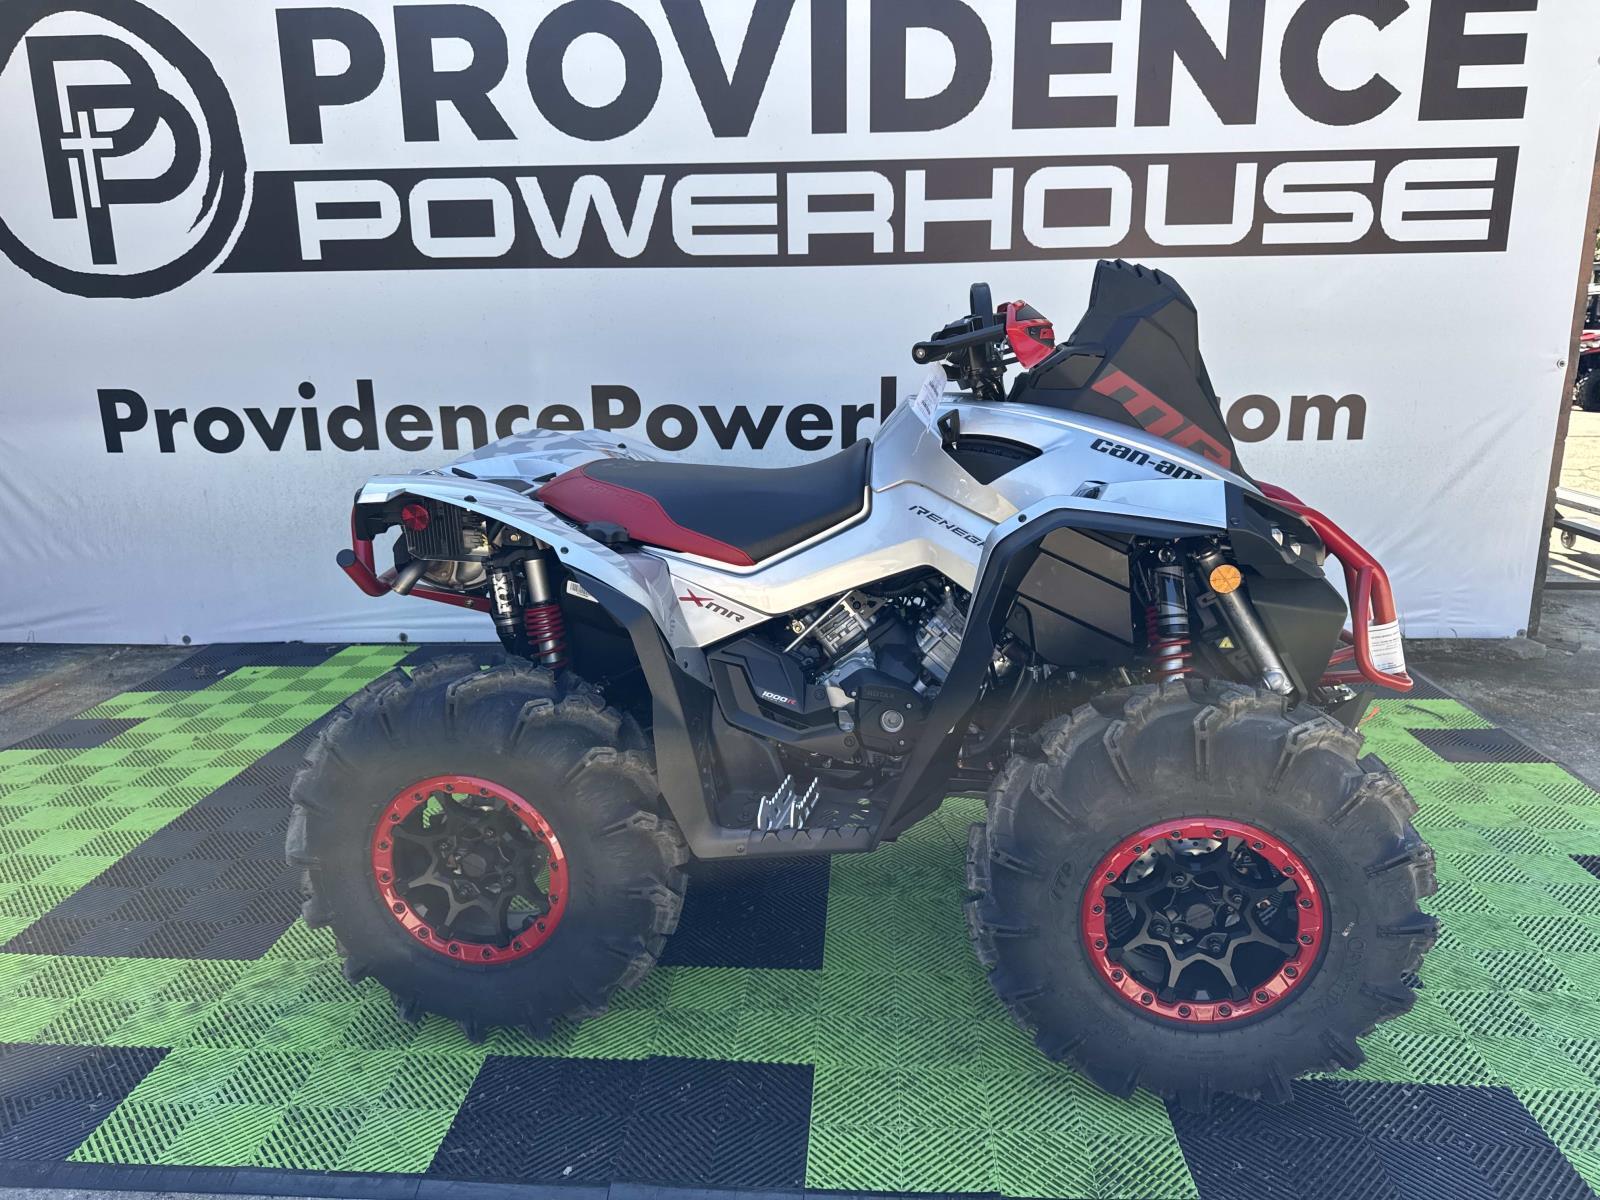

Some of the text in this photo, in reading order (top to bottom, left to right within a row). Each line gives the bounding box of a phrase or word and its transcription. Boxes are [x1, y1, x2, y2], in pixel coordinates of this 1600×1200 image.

[275, 0, 1538, 144] PROVIDENCE
[293, 157, 1498, 261] POWERHOUSE
[1090, 438, 1203, 480] can-am
